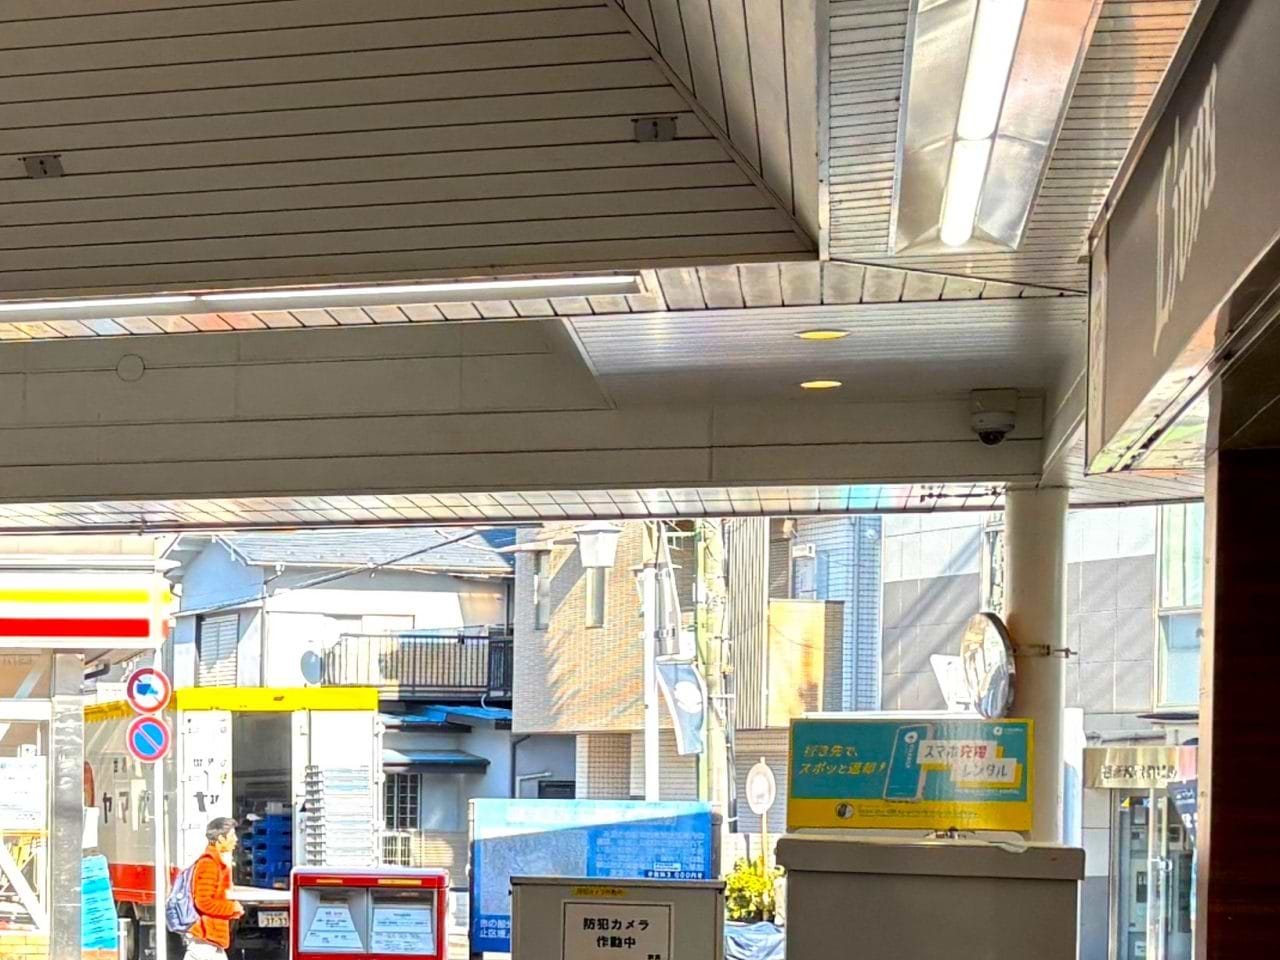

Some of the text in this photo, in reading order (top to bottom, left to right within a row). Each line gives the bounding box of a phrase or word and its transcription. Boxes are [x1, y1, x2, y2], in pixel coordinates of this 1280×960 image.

[583, 917, 649, 931] 防犯カメラ
[596, 936, 636, 949] 作動中
